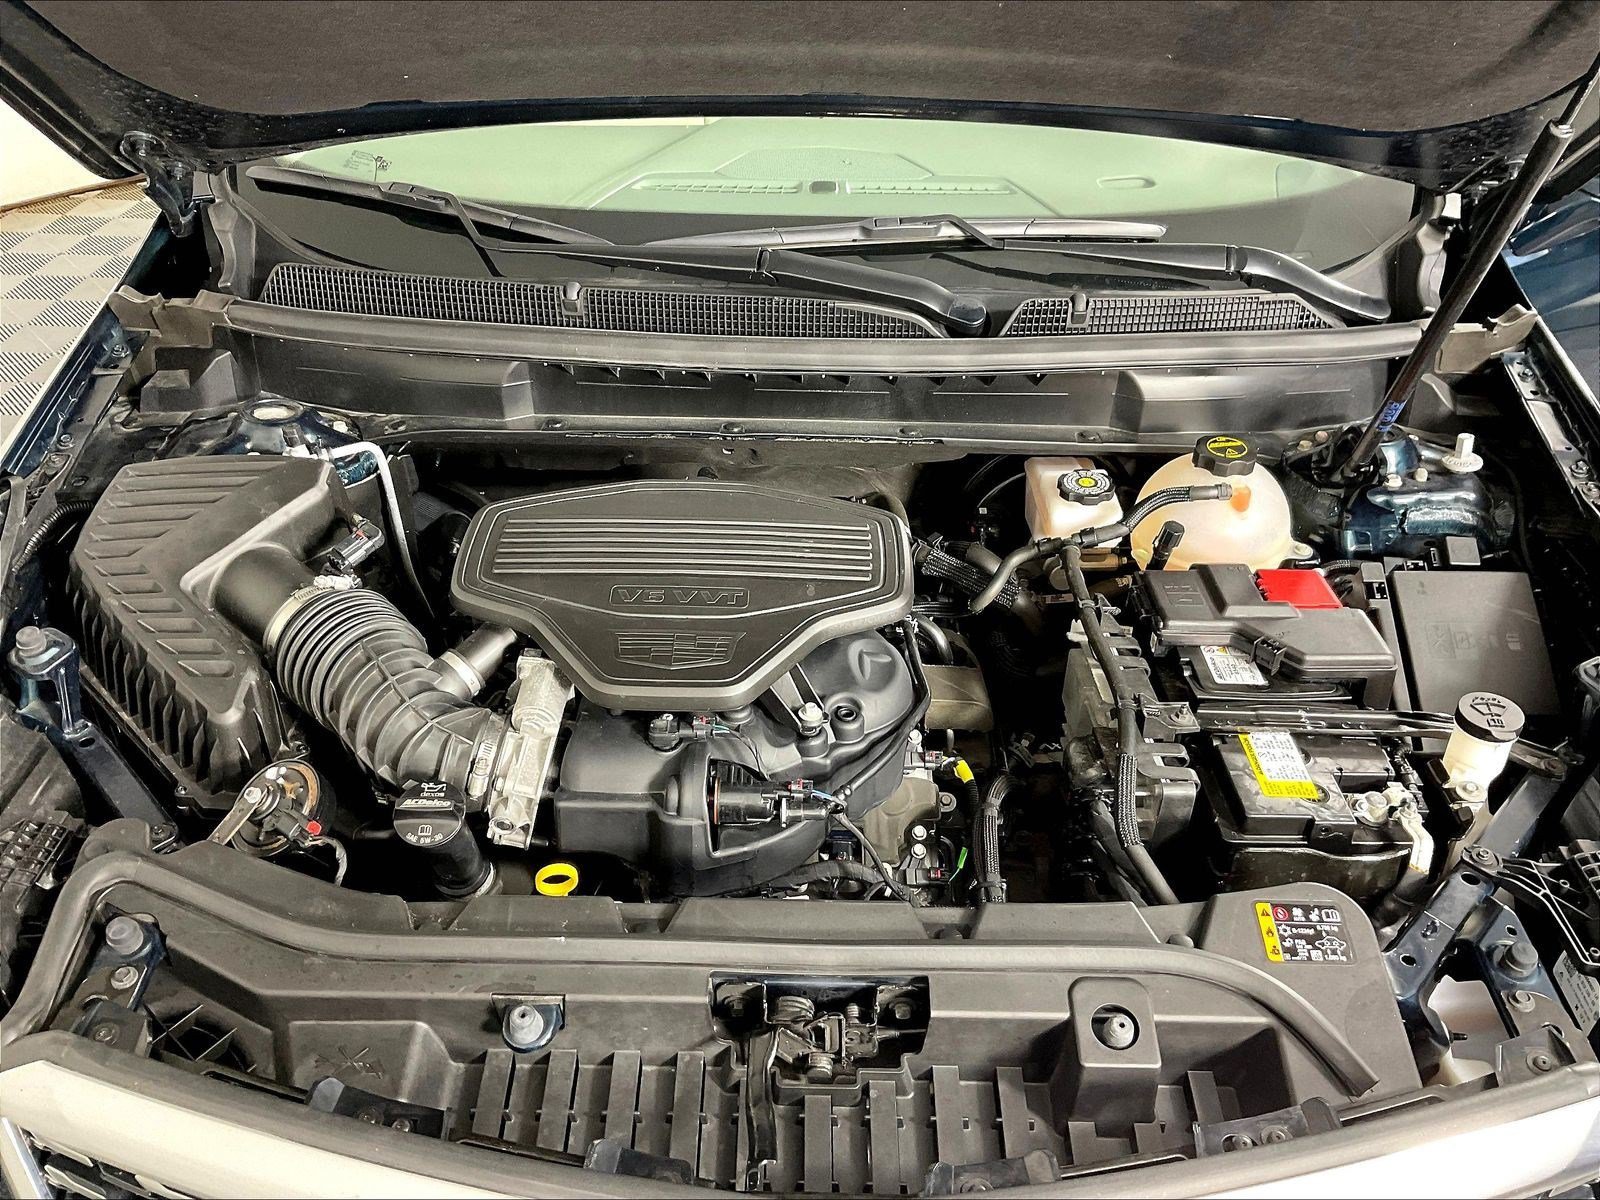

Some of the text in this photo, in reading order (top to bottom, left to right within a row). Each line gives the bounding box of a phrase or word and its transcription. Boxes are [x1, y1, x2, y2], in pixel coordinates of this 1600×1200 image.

[617, 589, 744, 605] V6 VVT
[400, 799, 452, 807] ACDelco
[406, 832, 442, 844] SAE 5W-30
